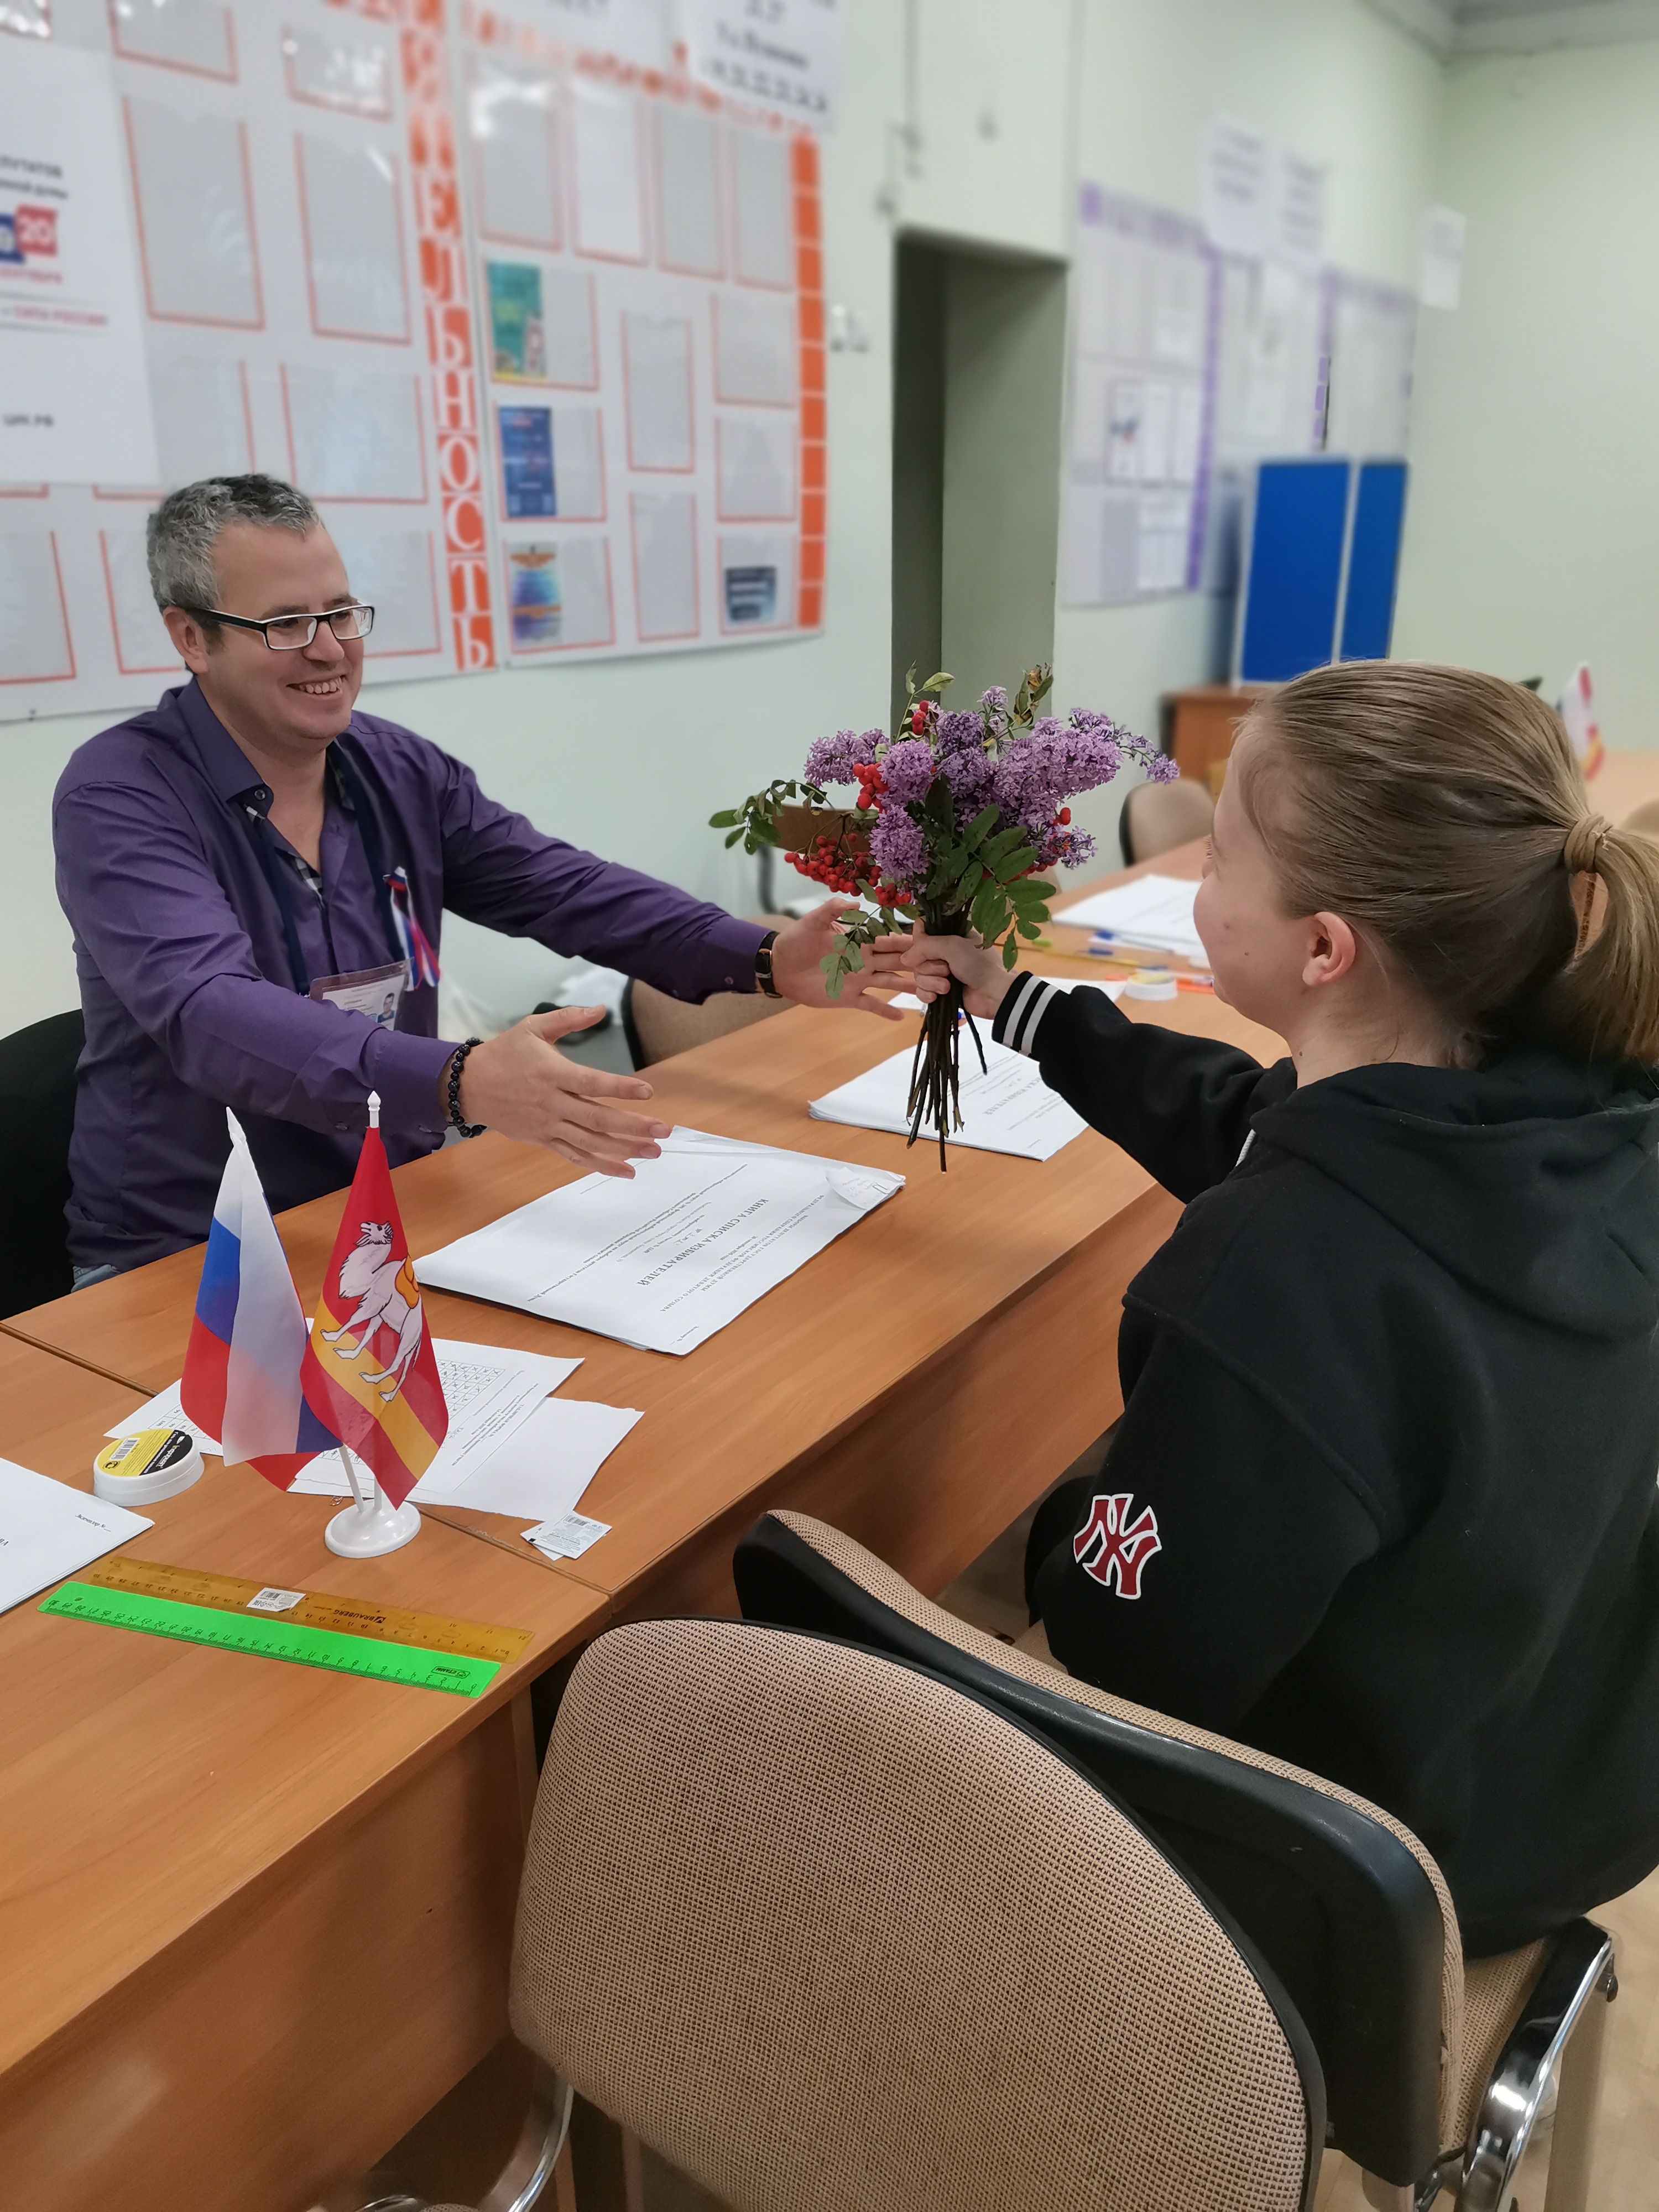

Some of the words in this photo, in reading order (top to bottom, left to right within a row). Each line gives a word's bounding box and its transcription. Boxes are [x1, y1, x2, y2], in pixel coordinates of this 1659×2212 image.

[19, 216, 56, 244] 20
[737, 1198, 769, 1218] КНИГА
[701, 1218, 740, 1243] СПИСКА
[637, 1243, 706, 1286] ИЗБИРАТЕЛЕЙ
[1073, 1493, 1162, 1600] NY
[333, 1609, 375, 1621] BRAUBERG
